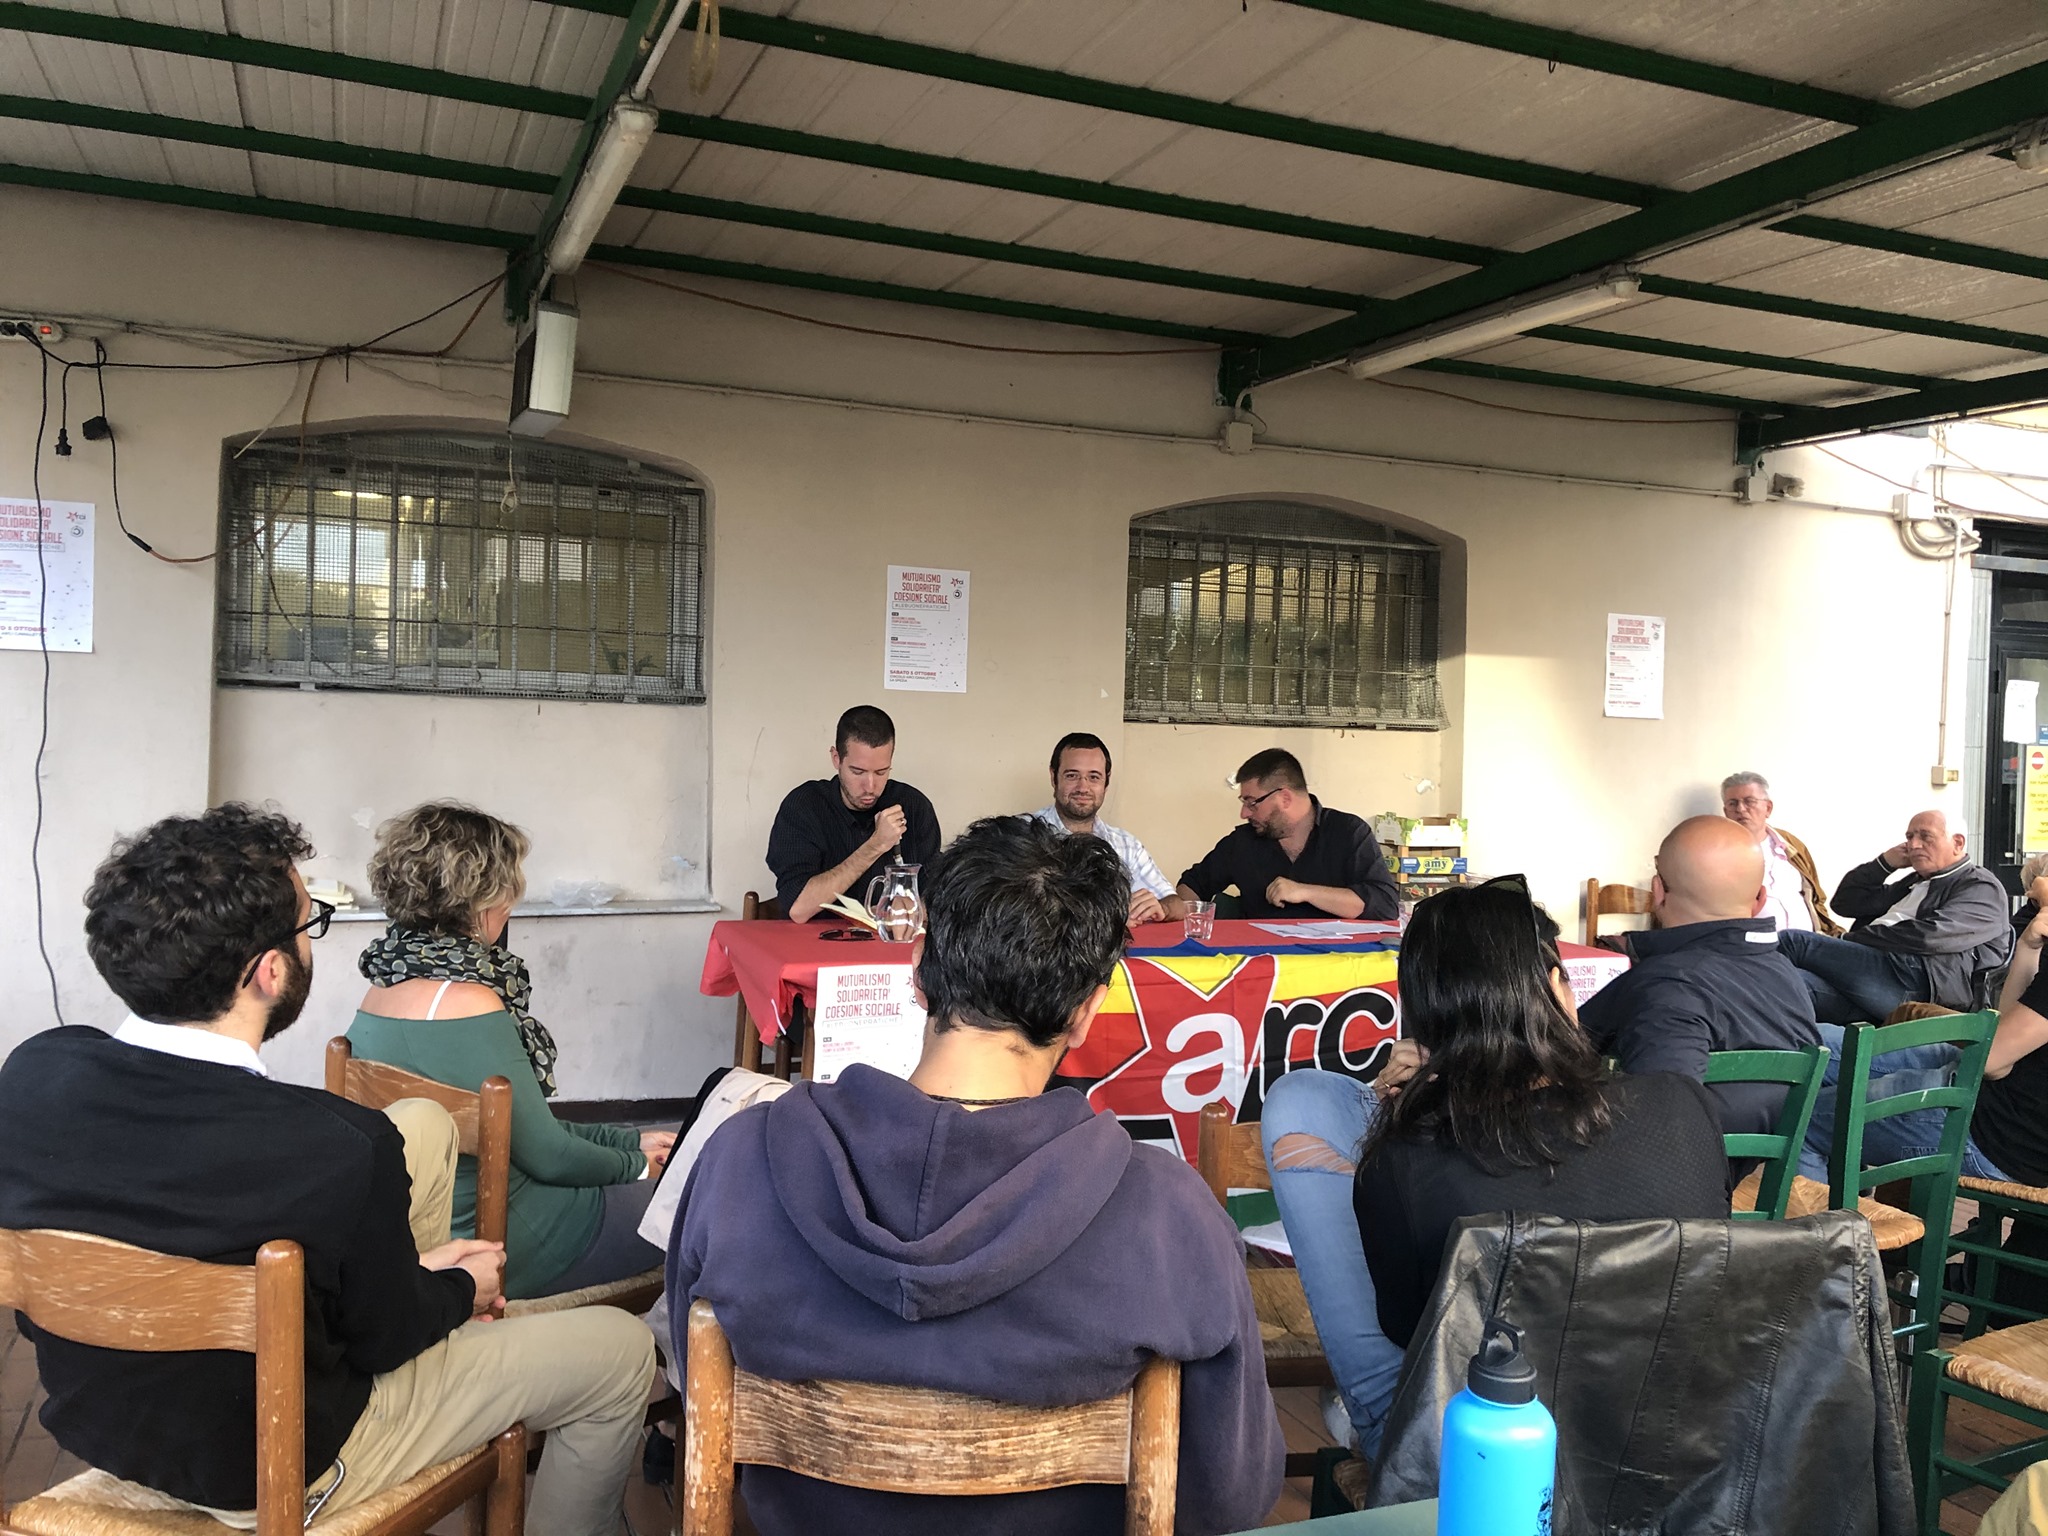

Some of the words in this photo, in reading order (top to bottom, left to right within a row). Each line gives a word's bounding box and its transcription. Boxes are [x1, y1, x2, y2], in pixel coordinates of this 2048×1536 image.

[902, 572, 941, 583] MUTUALISMO
[902, 582, 941, 593] SOLIDARIETA'
[894, 592, 922, 603] COESIONE
[924, 594, 948, 604] SOCIALE
[1424, 860, 1448, 869] amy
[837, 973, 891, 987] MUTUALISMO
[837, 988, 891, 1003] SOLIDARIETA'
[825, 1004, 863, 1019] COESIONE
[865, 1003, 900, 1016] SOCIALE
